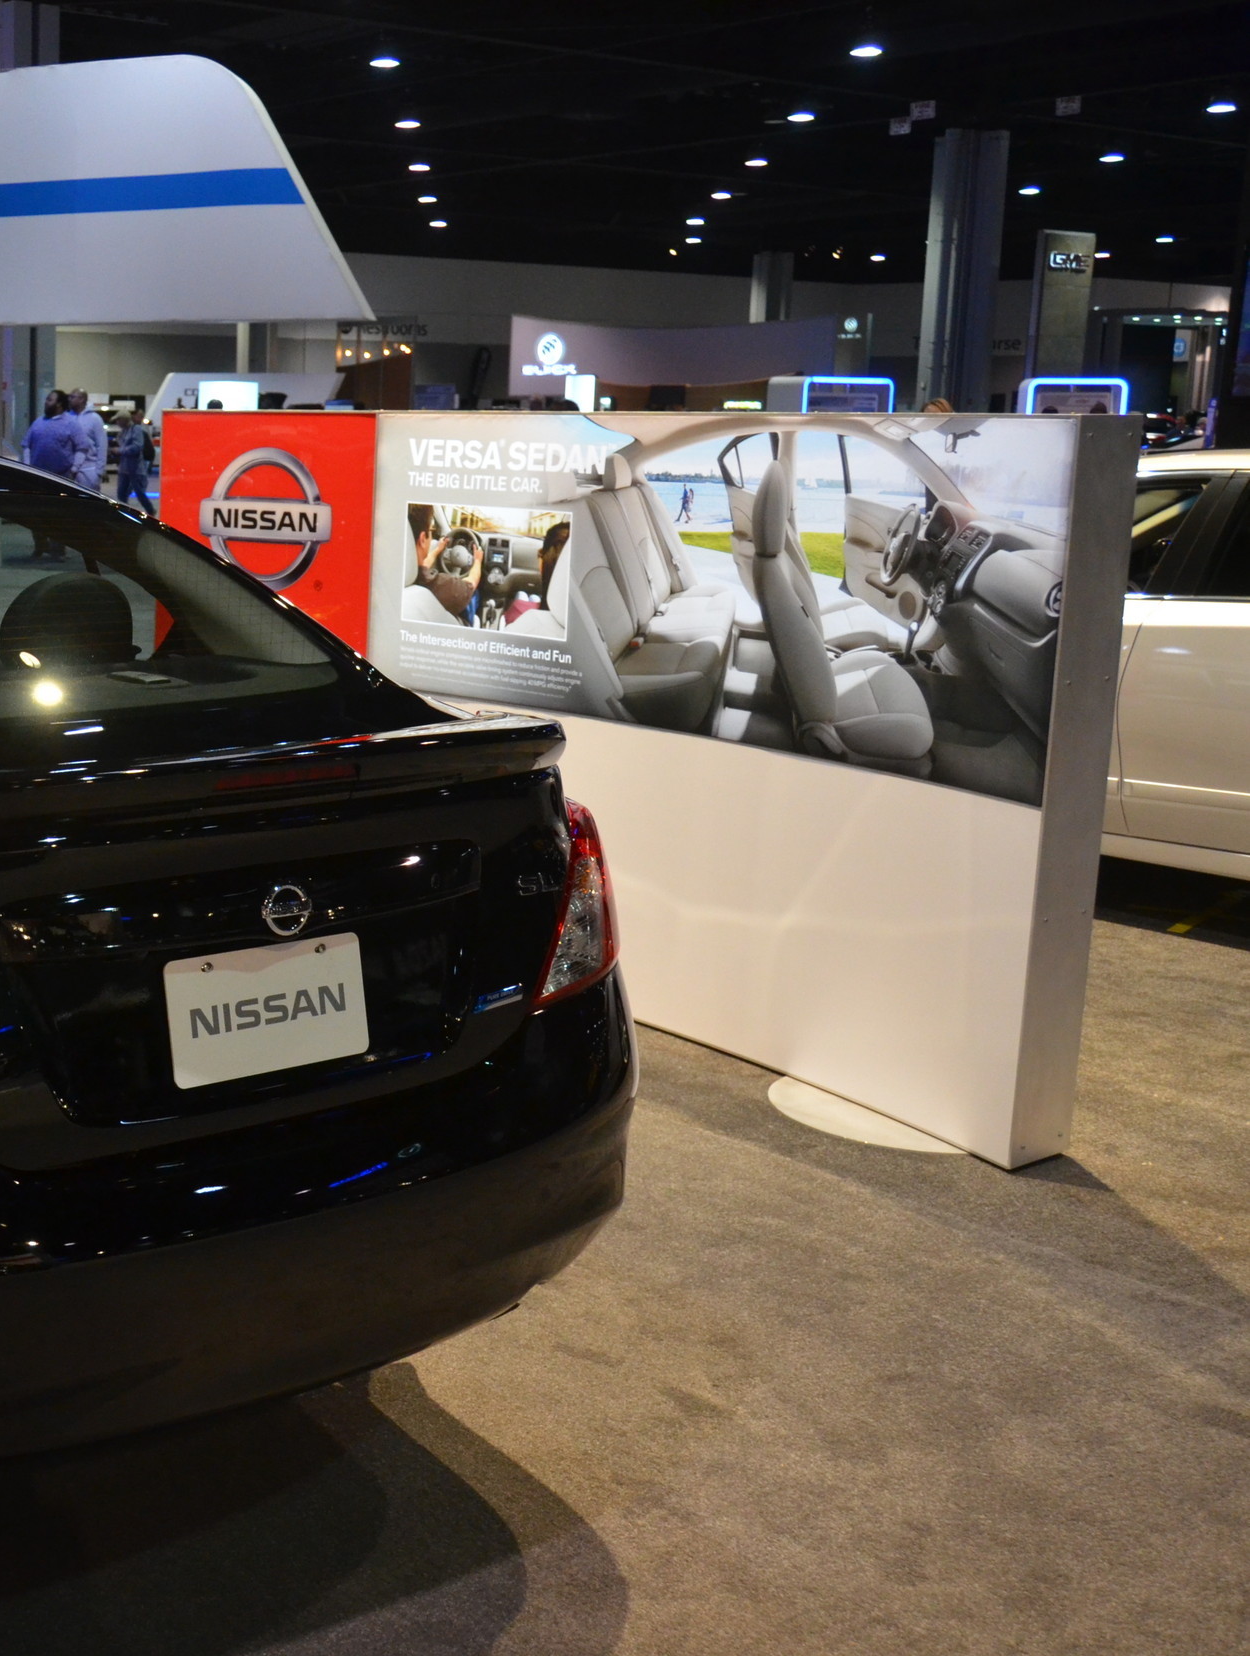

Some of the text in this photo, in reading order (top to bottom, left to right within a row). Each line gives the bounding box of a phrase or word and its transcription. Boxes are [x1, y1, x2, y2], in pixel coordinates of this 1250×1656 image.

[408, 437, 607, 475] VERSA SEDAN
[408, 471, 543, 494] THE BIG LITTLE CAR.
[212, 507, 318, 533] NISSAN
[400, 629, 418, 643] The
[419, 632, 476, 652] Intersection
[477, 640, 488, 653] of
[489, 641, 531, 659] Efficient
[531, 648, 551, 661] and
[552, 650, 572, 665] Fun
[188, 982, 347, 1039] NISSAN
